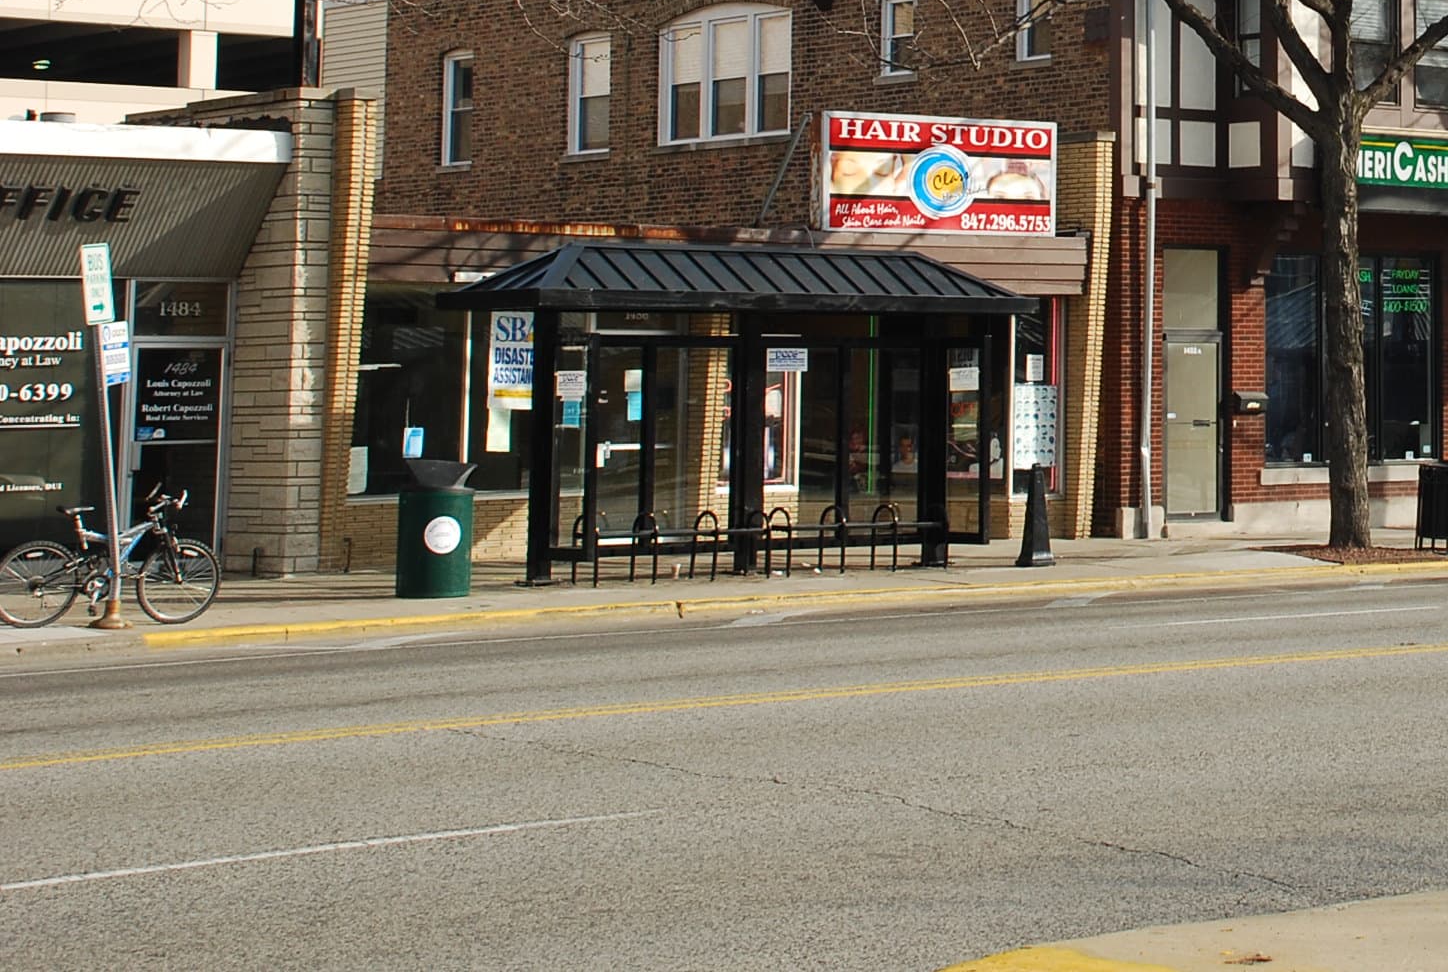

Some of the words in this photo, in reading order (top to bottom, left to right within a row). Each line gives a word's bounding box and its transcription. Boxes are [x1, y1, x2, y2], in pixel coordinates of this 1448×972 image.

[839, 119, 921, 143] HAIR
[931, 124, 1049, 149] STUDIO
[835, 203, 850, 215] All
[960, 213, 1051, 232] 847.296.5753
[159, 301, 201, 317] 1484
[21, 356, 33, 366] at
[36, 354, 62, 366] Law
[146, 379, 169, 388] Louis
[171, 379, 212, 390] Capozzoli
[141, 404, 171, 413] Robert
[173, 403, 213, 413] Capozzoli
